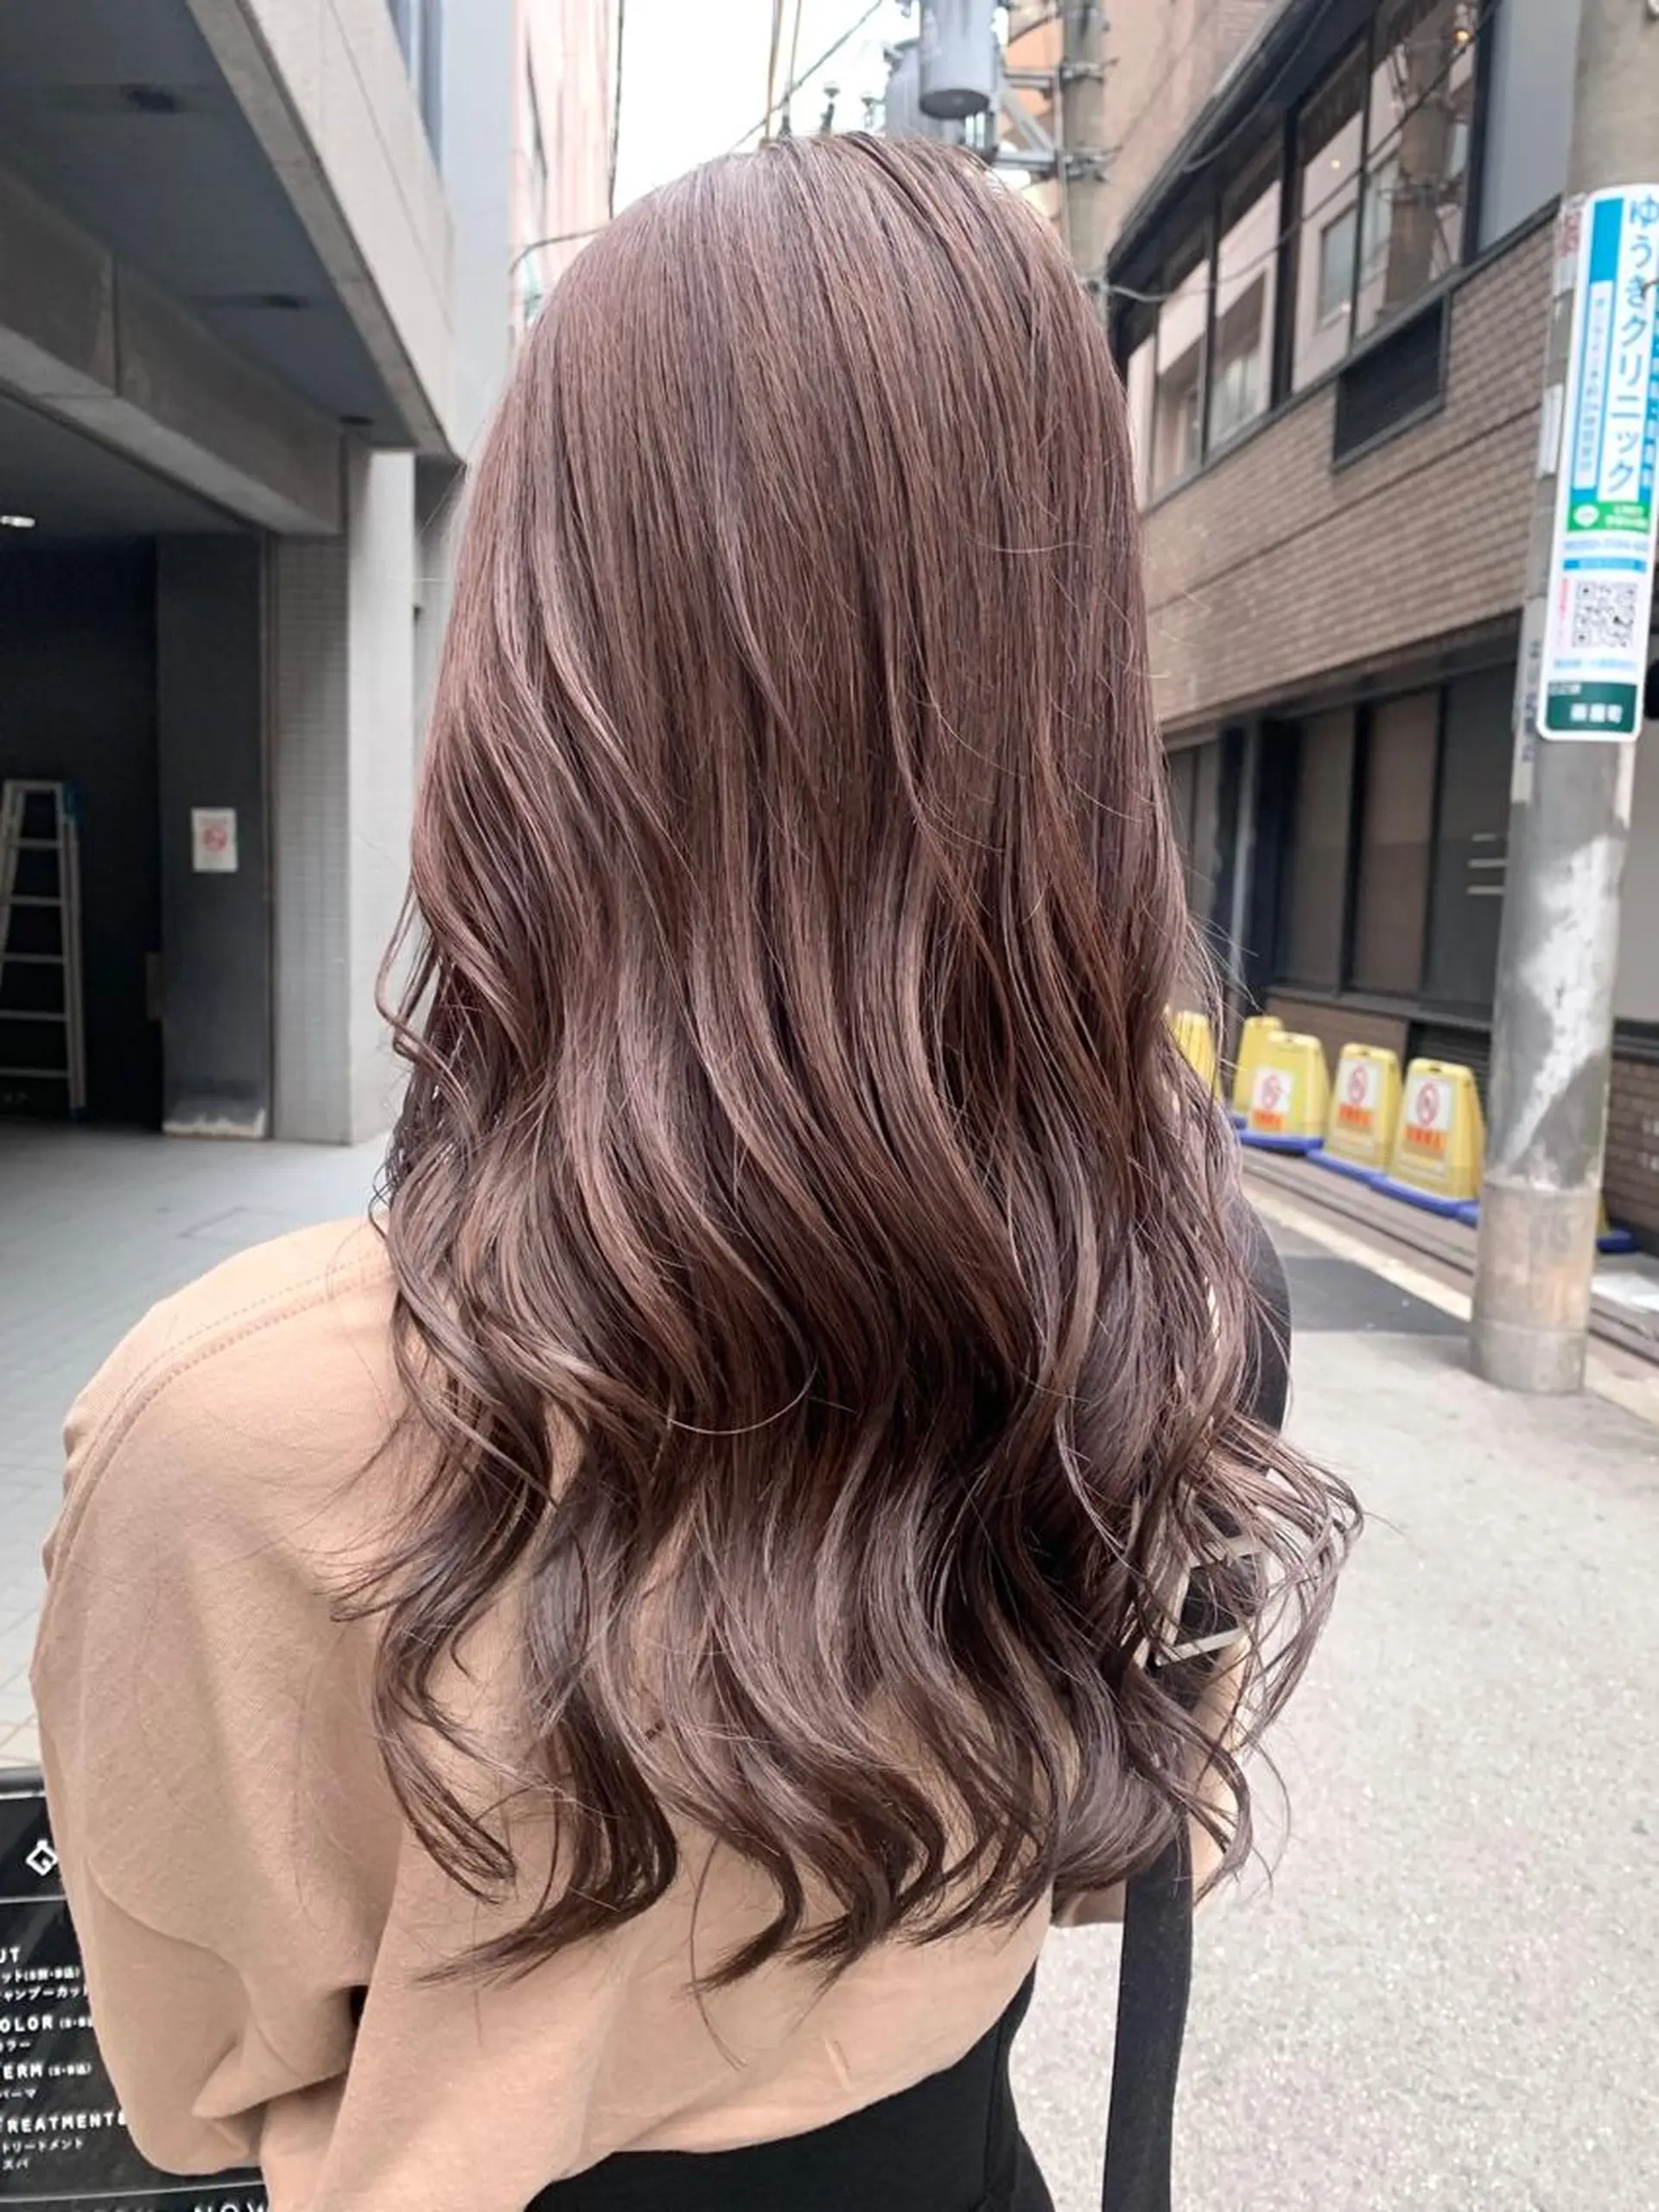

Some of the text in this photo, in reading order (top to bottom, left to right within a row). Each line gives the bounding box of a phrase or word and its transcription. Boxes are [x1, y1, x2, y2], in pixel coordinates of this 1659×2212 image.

[1606, 194, 1659, 493] ゆうきクリニック
[3, 2137, 84, 2154] トリートメント
